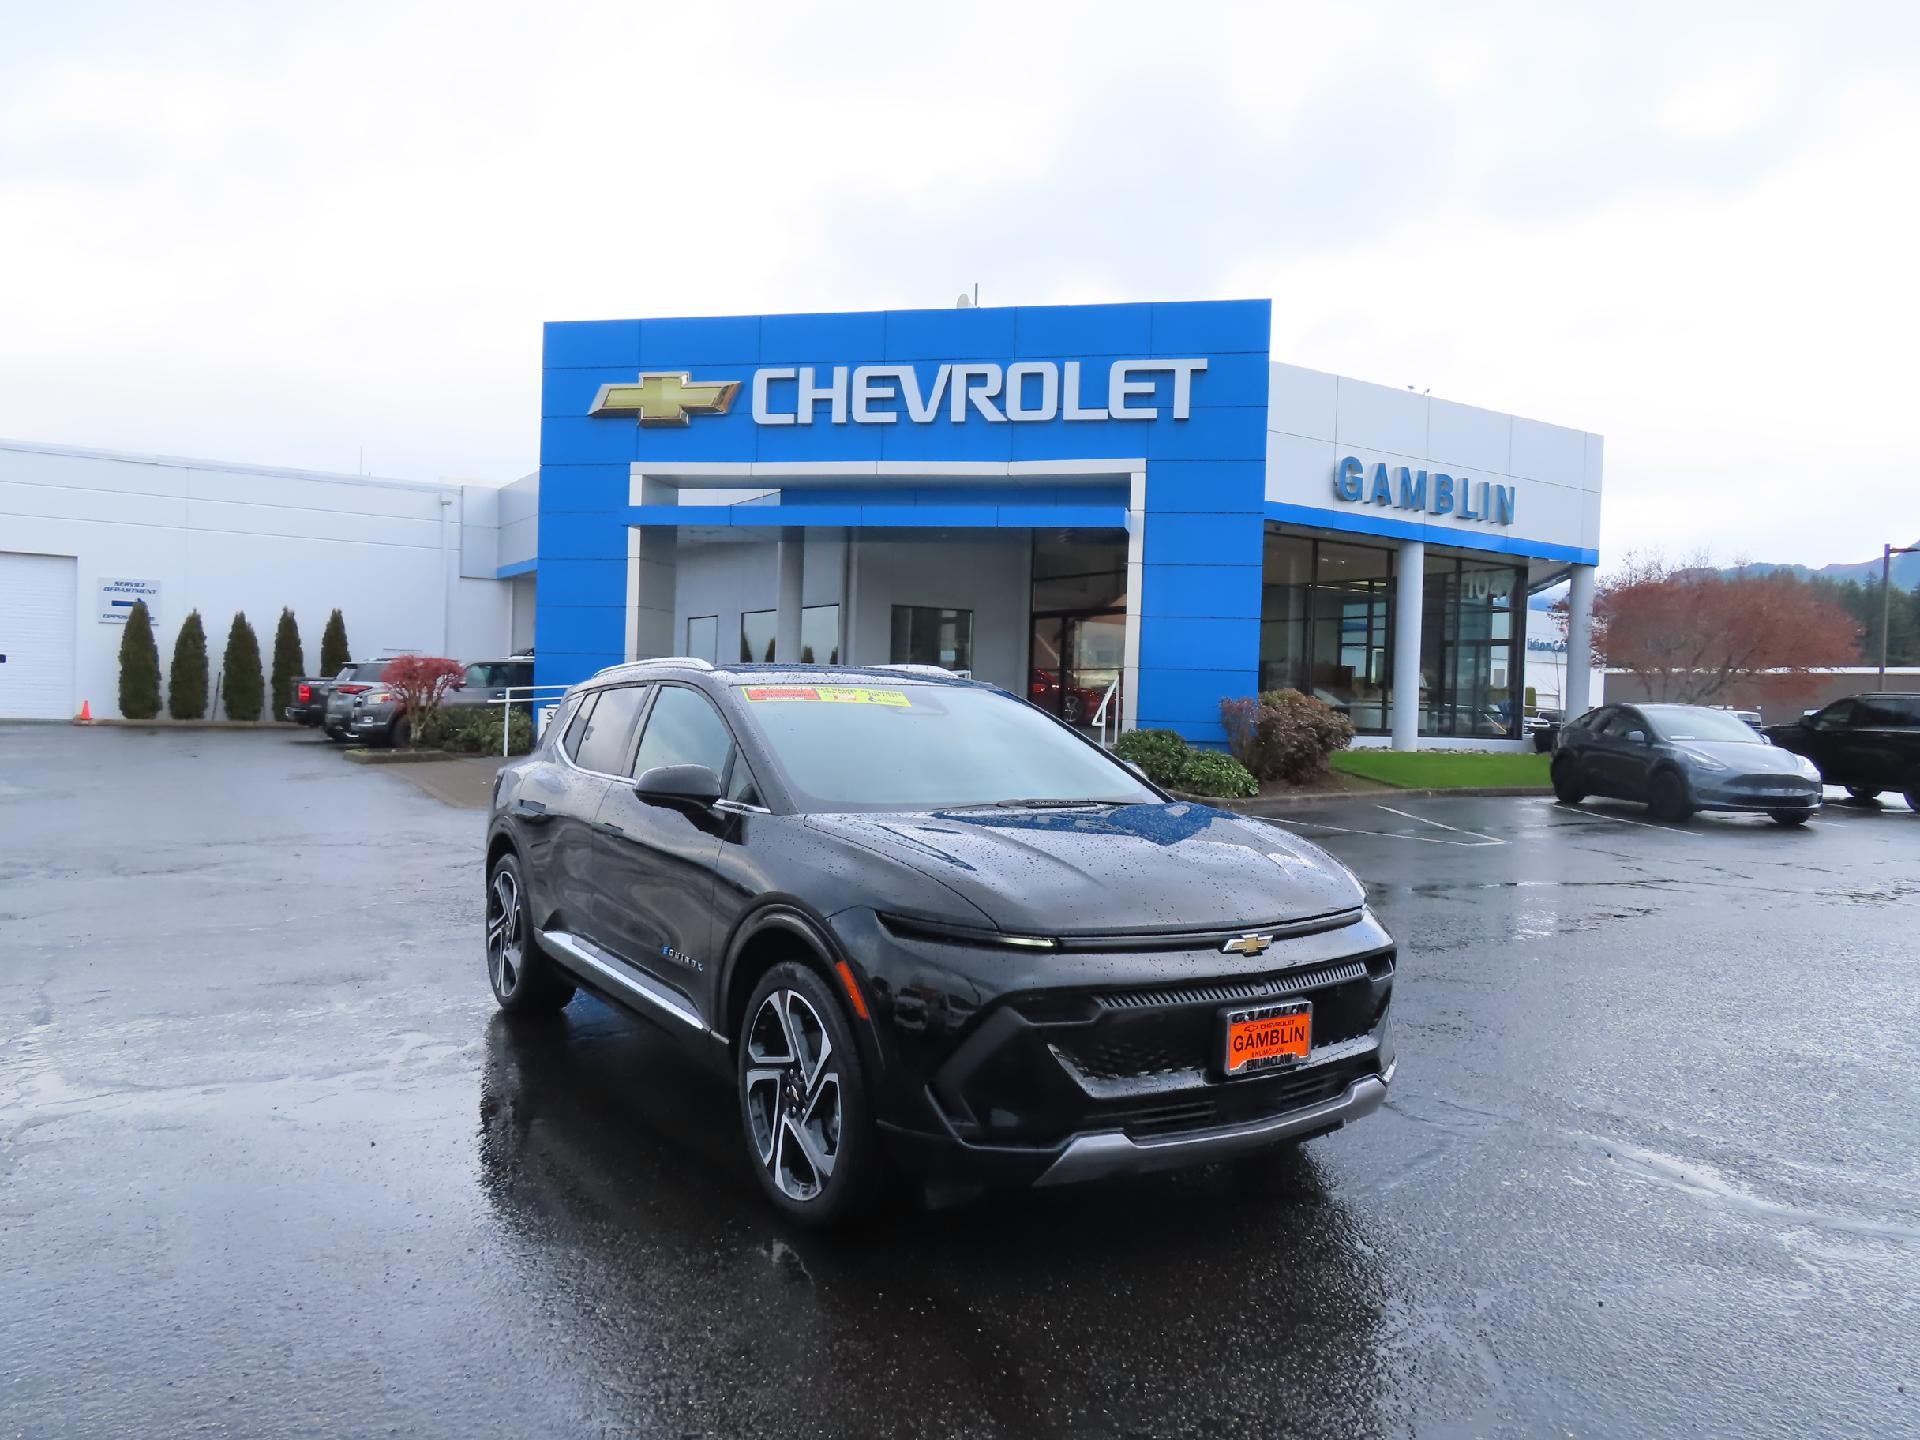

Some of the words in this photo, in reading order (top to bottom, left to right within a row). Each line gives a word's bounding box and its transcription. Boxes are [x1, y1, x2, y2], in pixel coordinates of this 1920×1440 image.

[752, 359, 1208, 425] CHEVROLET
[1334, 456, 1516, 526] GAMBLIN
[103, 586, 157, 595] DEPARTMENT
[1231, 1002, 1310, 1023] GAMBLIN
[1260, 1019, 1295, 1030] CHEVROLET
[1233, 1026, 1305, 1053] GAMBLIN
[1246, 1052, 1294, 1071] ENUMCLAW
